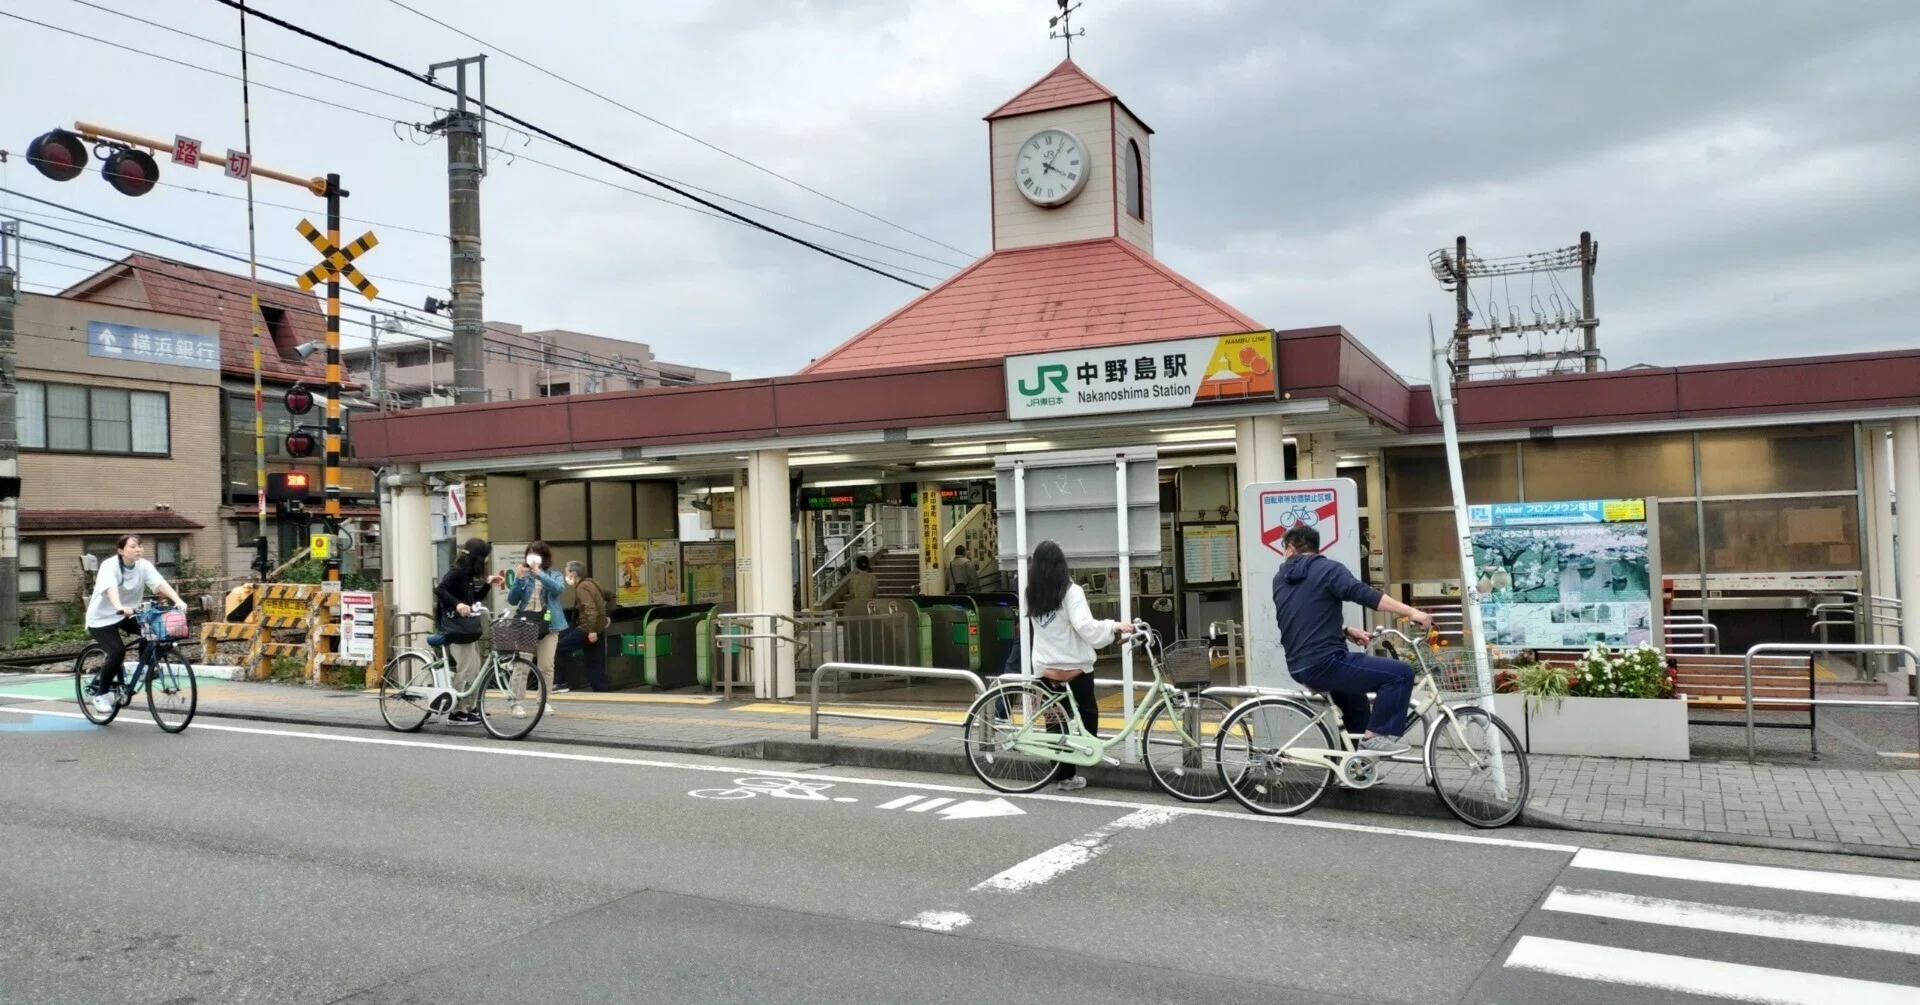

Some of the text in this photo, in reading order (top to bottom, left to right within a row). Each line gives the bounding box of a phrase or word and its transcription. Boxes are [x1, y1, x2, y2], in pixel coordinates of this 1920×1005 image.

[174, 140, 250, 178] 踏 切
[132, 333, 214, 363] 横浜銀行
[1224, 335, 1267, 345] NAMBU LINE
[1018, 363, 1069, 396] JR
[1076, 353, 1188, 386] 中野島駅
[1026, 396, 1064, 408] JR東日本
[1078, 382, 1192, 404] Nakanoshima Station
[1264, 493, 1332, 504] 自転車等放置禁止区域
[1495, 506, 1523, 514] Anker
[1526, 502, 1598, 513] フロンタウン生田
